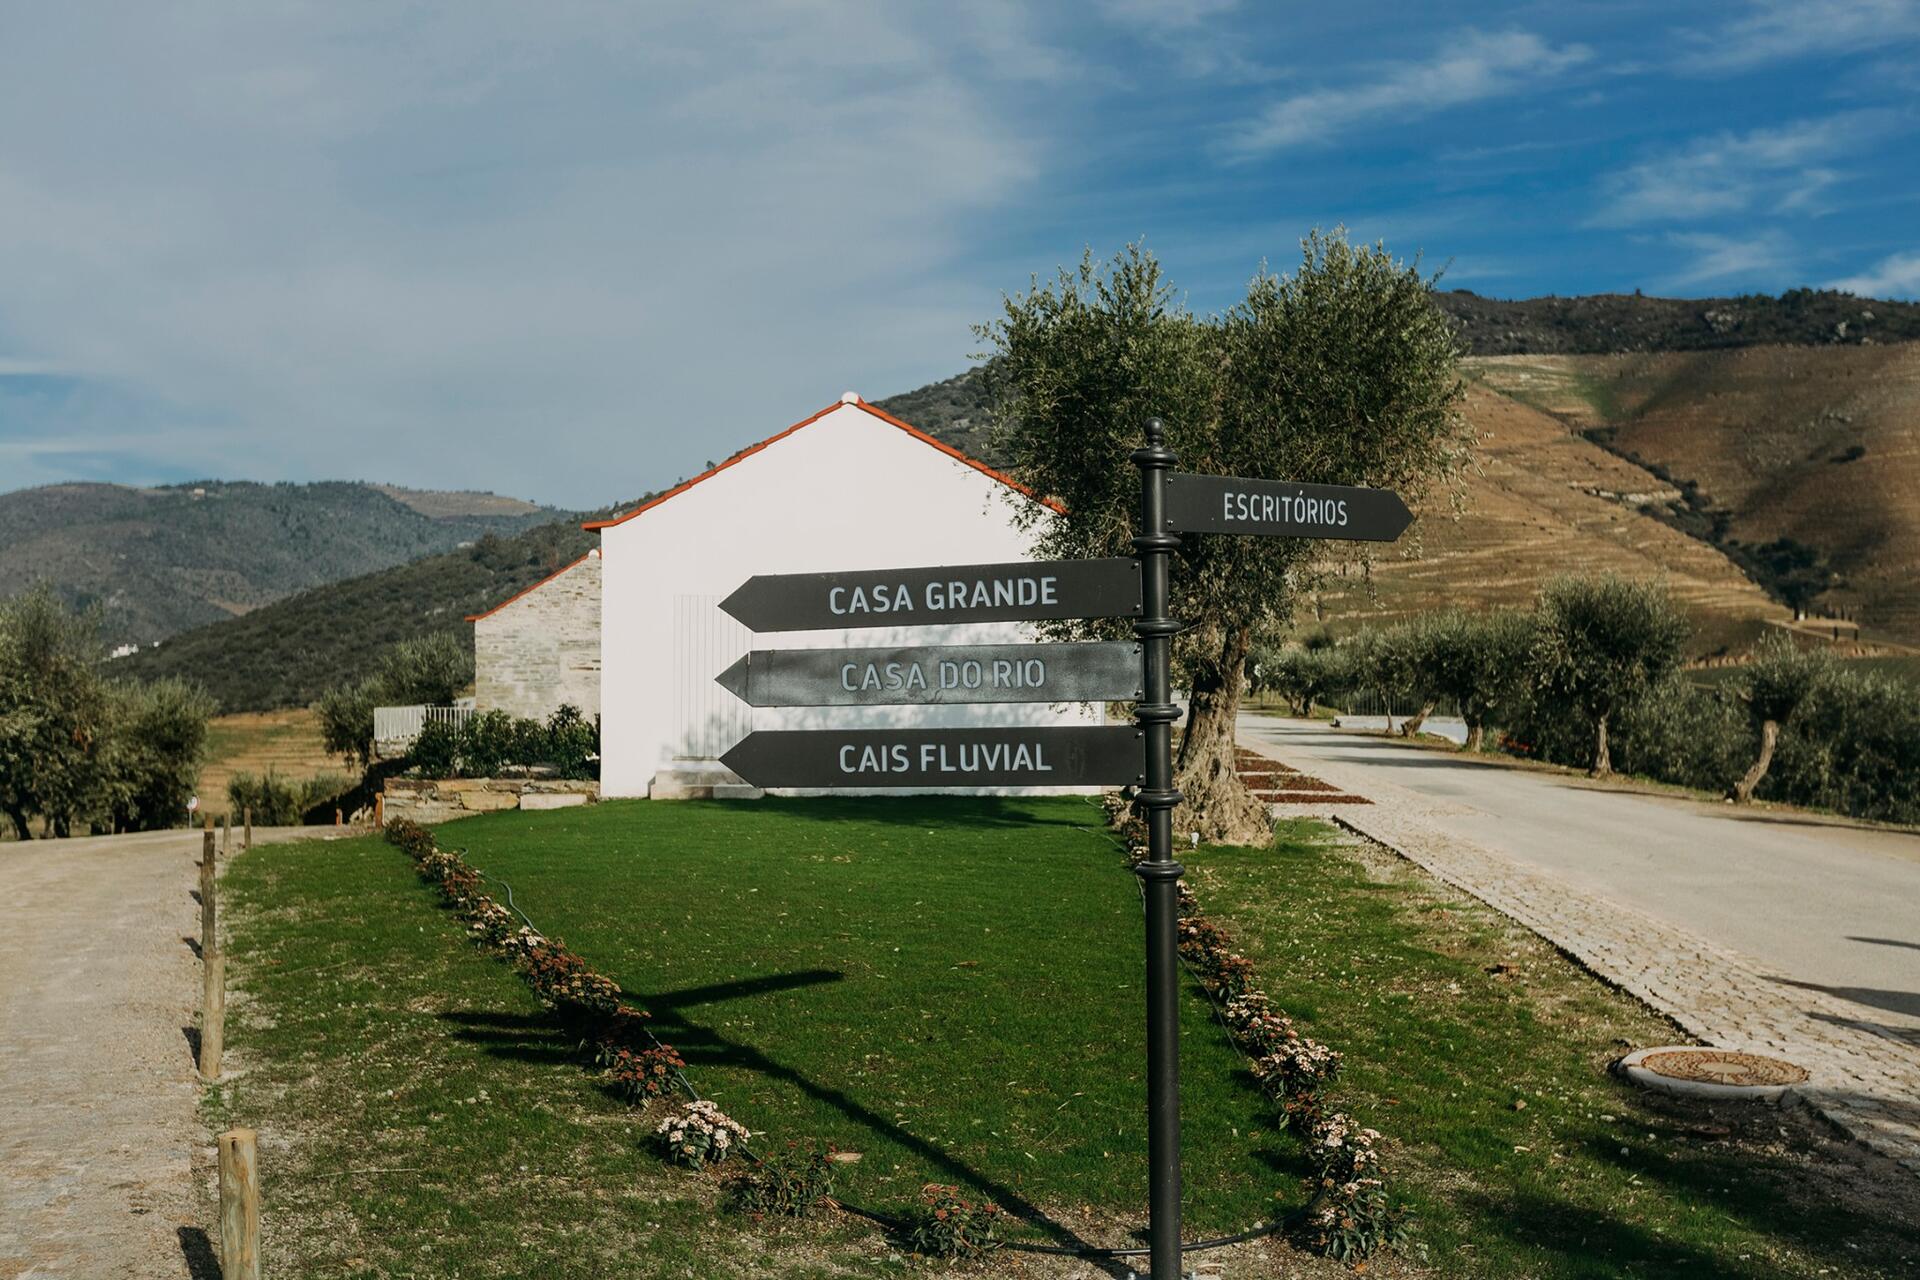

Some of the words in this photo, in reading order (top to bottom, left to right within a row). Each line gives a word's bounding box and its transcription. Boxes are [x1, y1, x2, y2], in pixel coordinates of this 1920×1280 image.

[1224, 490, 1348, 526] ESCRITÓRIOS
[829, 584, 914, 615] CASA
[925, 577, 1058, 610] GRANDE
[842, 662, 927, 691] CASA
[940, 661, 982, 689] DO
[993, 659, 1046, 688] RIO
[839, 744, 909, 773] CAIS
[920, 743, 1052, 772] FLUVIAL
